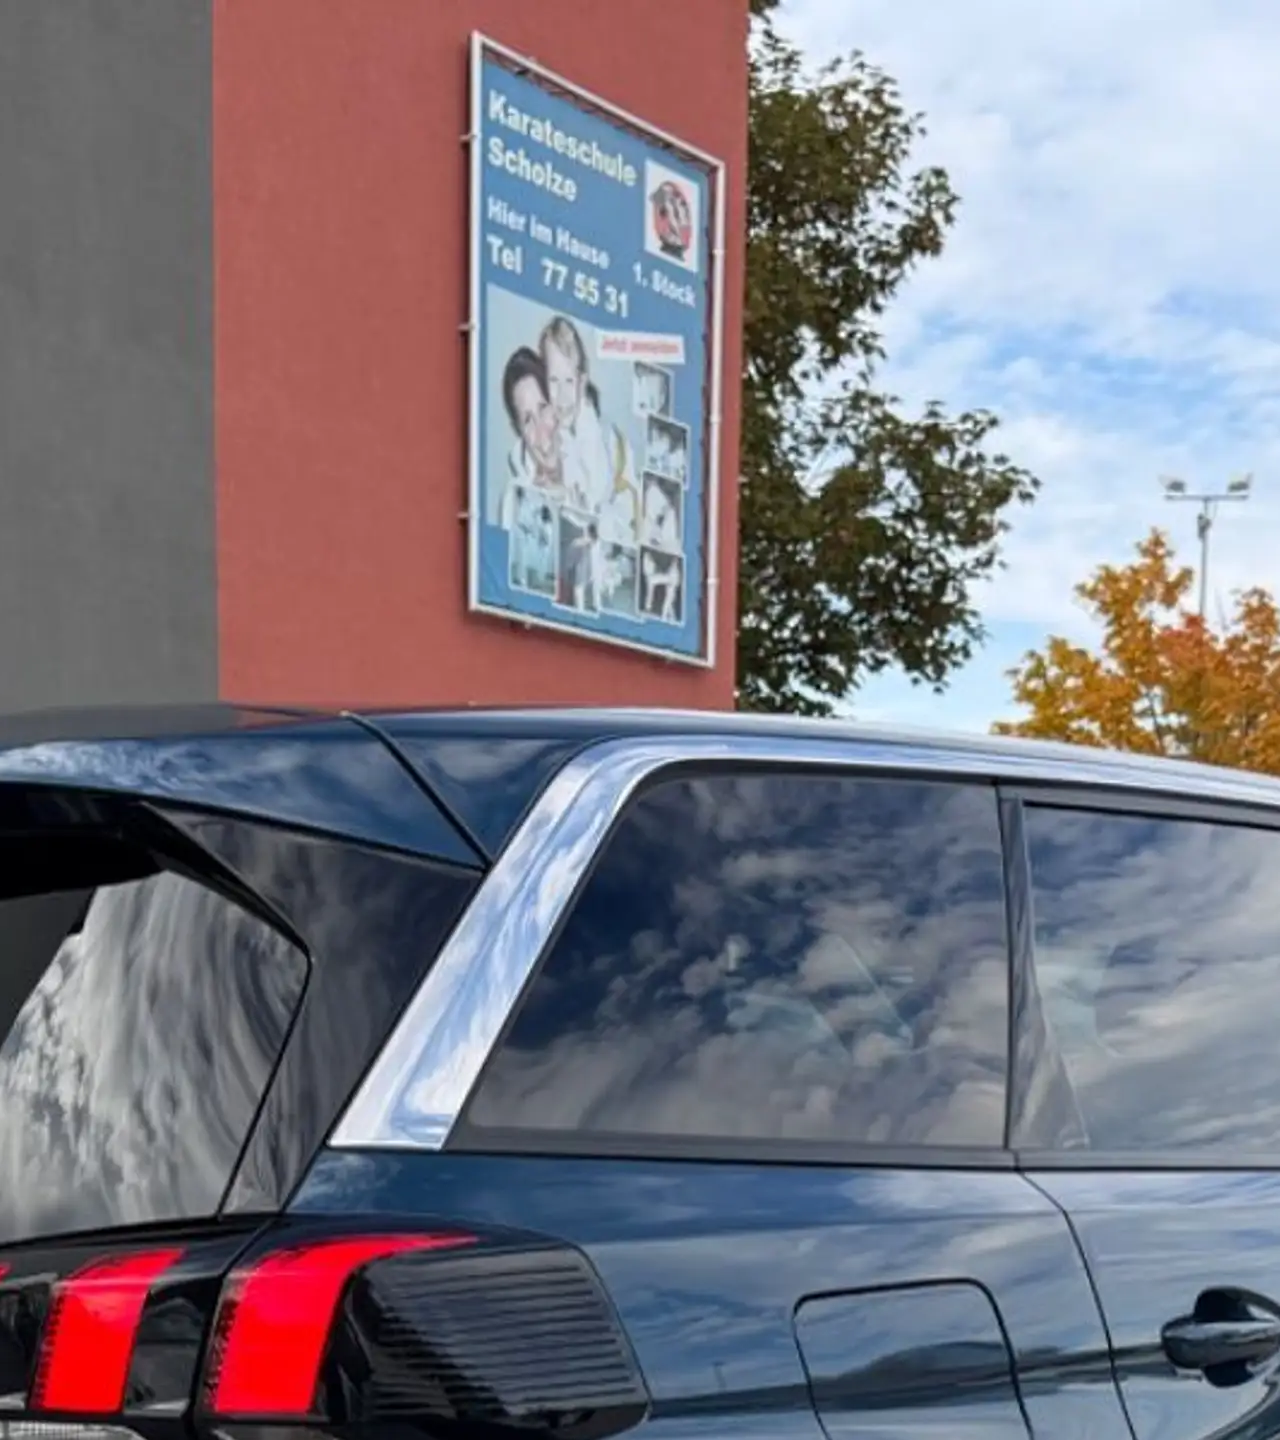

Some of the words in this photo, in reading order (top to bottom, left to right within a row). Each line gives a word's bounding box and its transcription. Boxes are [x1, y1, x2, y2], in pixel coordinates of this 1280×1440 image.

[488, 136, 577, 202] Scholze
[489, 89, 637, 187] Karateschule
[488, 196, 526, 232] Hier
[556, 225, 610, 270] Hause
[486, 233, 522, 275] Tel
[540, 256, 568, 291] 77
[574, 270, 600, 307] 55
[604, 284, 628, 319] 31
[633, 261, 648, 288] 1.
[652, 269, 696, 308] Stock
